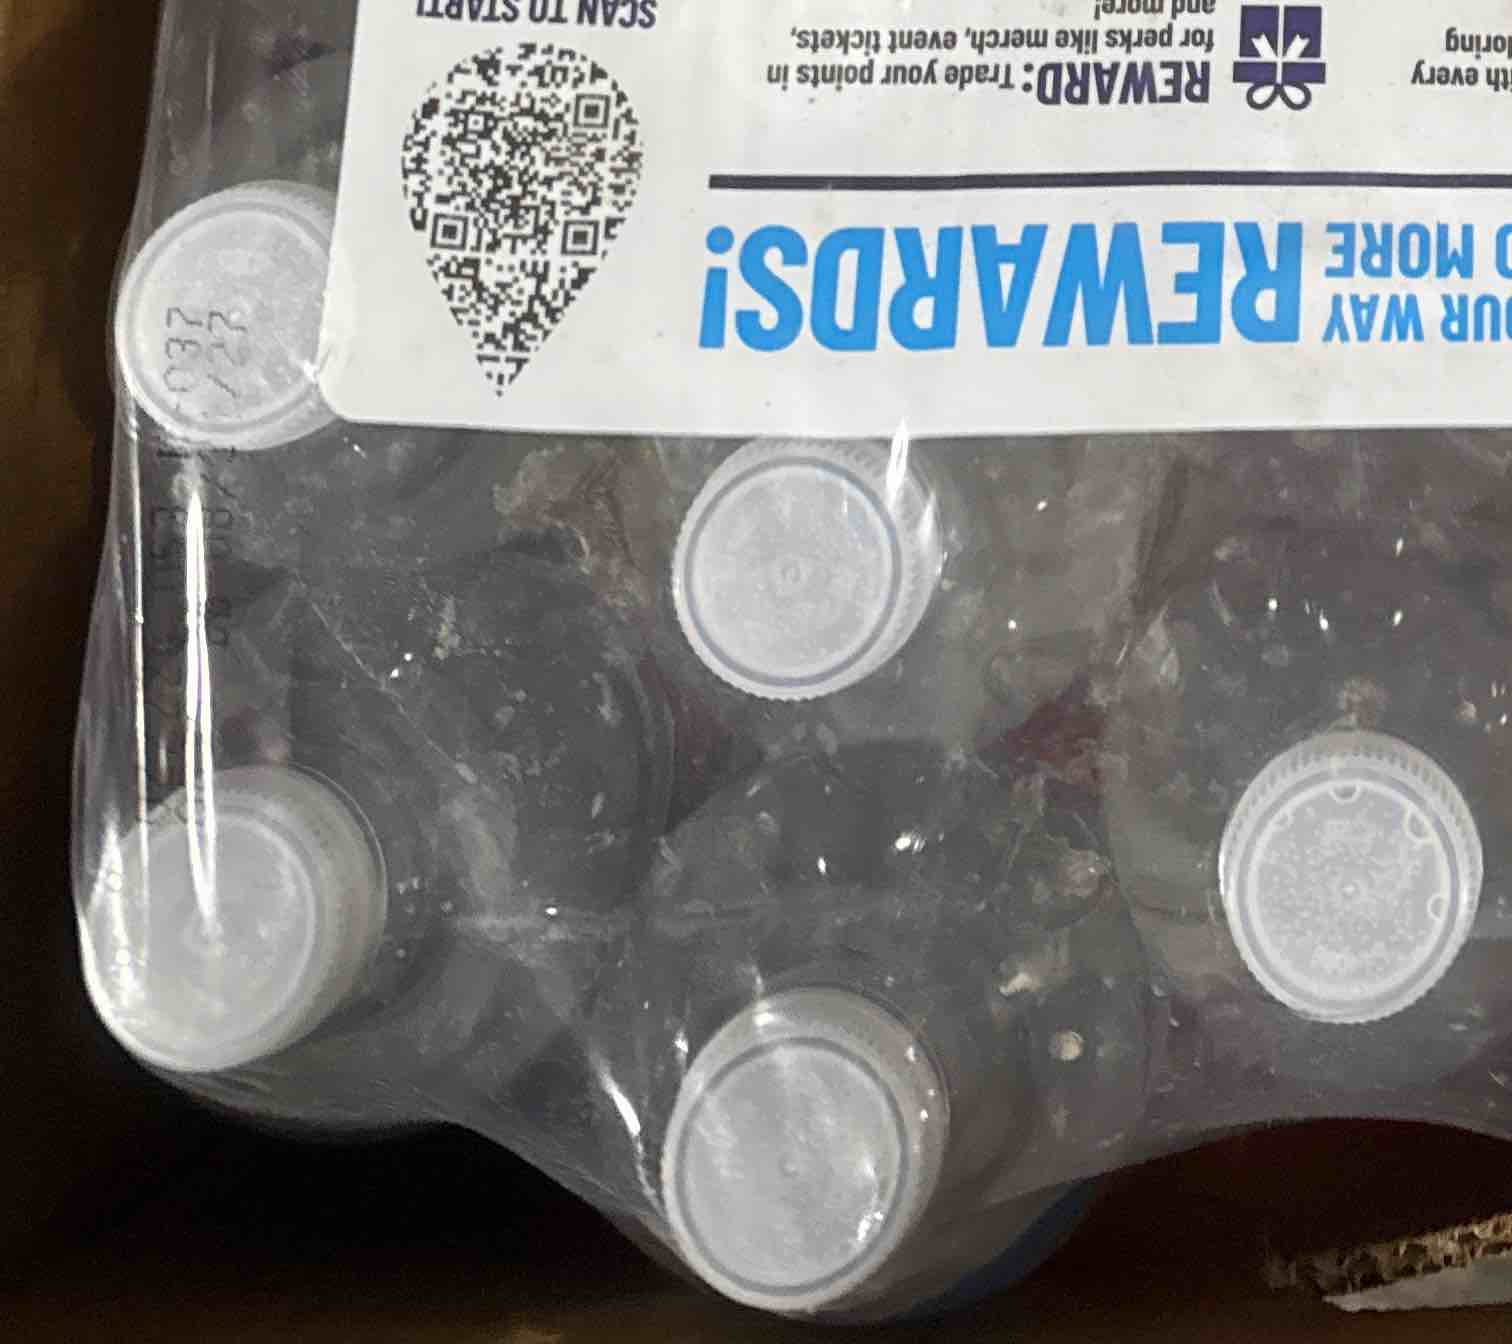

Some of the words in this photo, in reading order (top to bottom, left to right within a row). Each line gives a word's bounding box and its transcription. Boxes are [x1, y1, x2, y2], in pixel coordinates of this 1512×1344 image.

[790, 24, 882, 55] tickets,
[887, 28, 958, 54] event
[963, 24, 1050, 55] merch,
[1055, 28, 1099, 55] like
[1104, 21, 1173, 54] perks
[1179, 26, 1215, 54] for
[767, 63, 790, 92] in
[795, 59, 875, 92] points
[880, 58, 937, 89] your
[942, 62, 1015, 92] Trade
[1022, 61, 1212, 105] REWARD:
[1410, 59, 1480, 89] every
[1324, 223, 1474, 280] MORE
[698, 222, 1304, 353] REWARDS!
[1322, 294, 1425, 343] WAY
